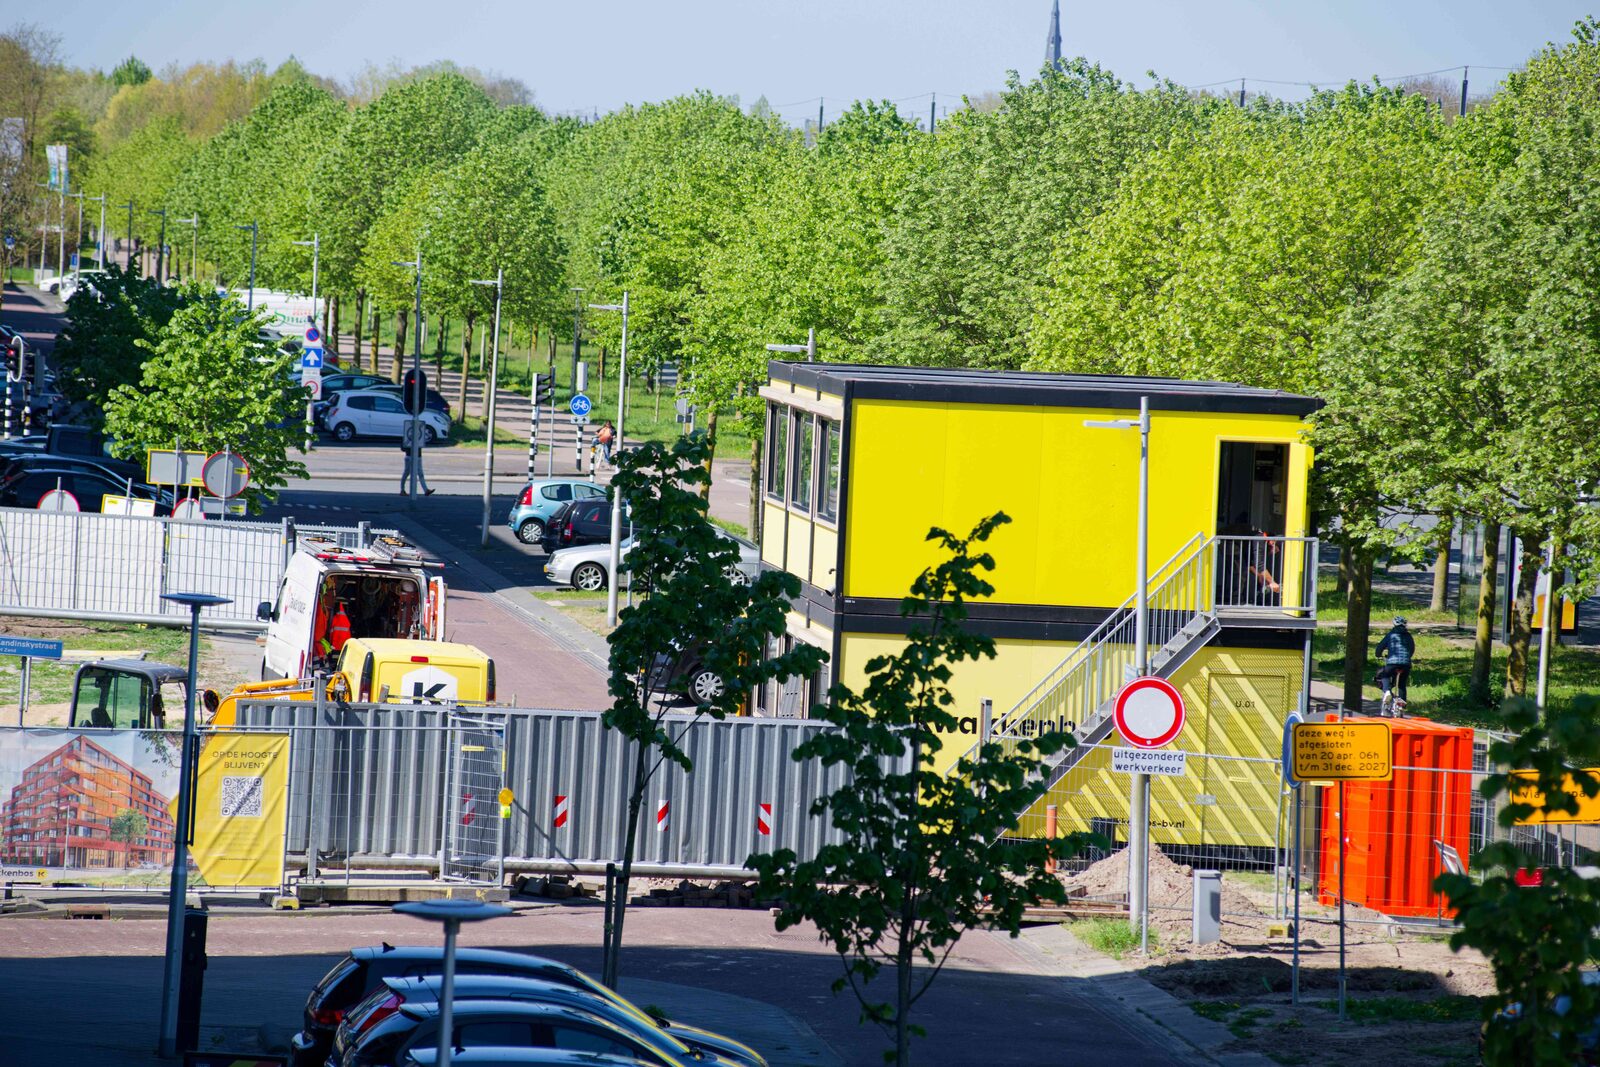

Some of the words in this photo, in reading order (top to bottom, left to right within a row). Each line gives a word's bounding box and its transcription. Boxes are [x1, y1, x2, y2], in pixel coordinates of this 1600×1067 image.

[0, 640, 57, 650] andinskystraat
[414, 682, 447, 705] K
[1299, 730, 1322, 738] deze
[1325, 731, 1344, 739] weg
[1347, 730, 1356, 738] is
[1299, 741, 1352, 751] afgesloten
[228, 751, 238, 759] DE
[240, 751, 279, 759] HOOGTE
[1113, 751, 1184, 762] uitgezonderd
[1320, 752, 1334, 760] 20
[1336, 753, 1356, 761] apr.
[1359, 752, 1380, 760] 06h
[1115, 763, 1182, 774] werkverkeer
[1299, 763, 1320, 772] t/m
[1322, 763, 1333, 771] 31
[1335, 763, 1355, 771] dec.
[1359, 762, 1386, 771] 2027
[0, 869, 34, 877] kenbos
